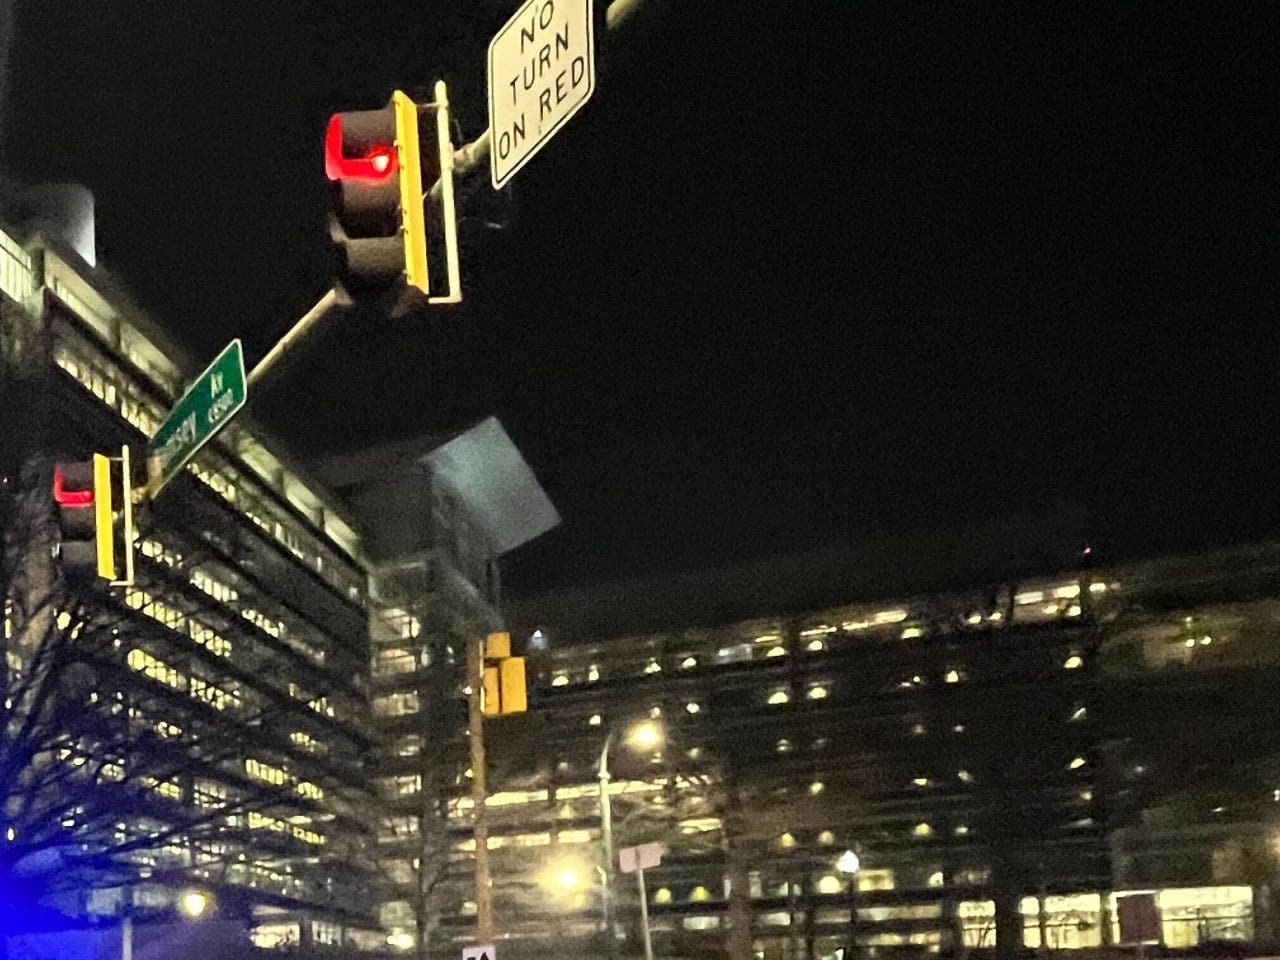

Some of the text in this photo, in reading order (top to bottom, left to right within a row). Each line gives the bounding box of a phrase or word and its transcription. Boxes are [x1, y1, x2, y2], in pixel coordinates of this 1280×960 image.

[510, 23, 569, 106] TURN
[521, 1, 554, 54] NO
[499, 56, 584, 160] ON RED
